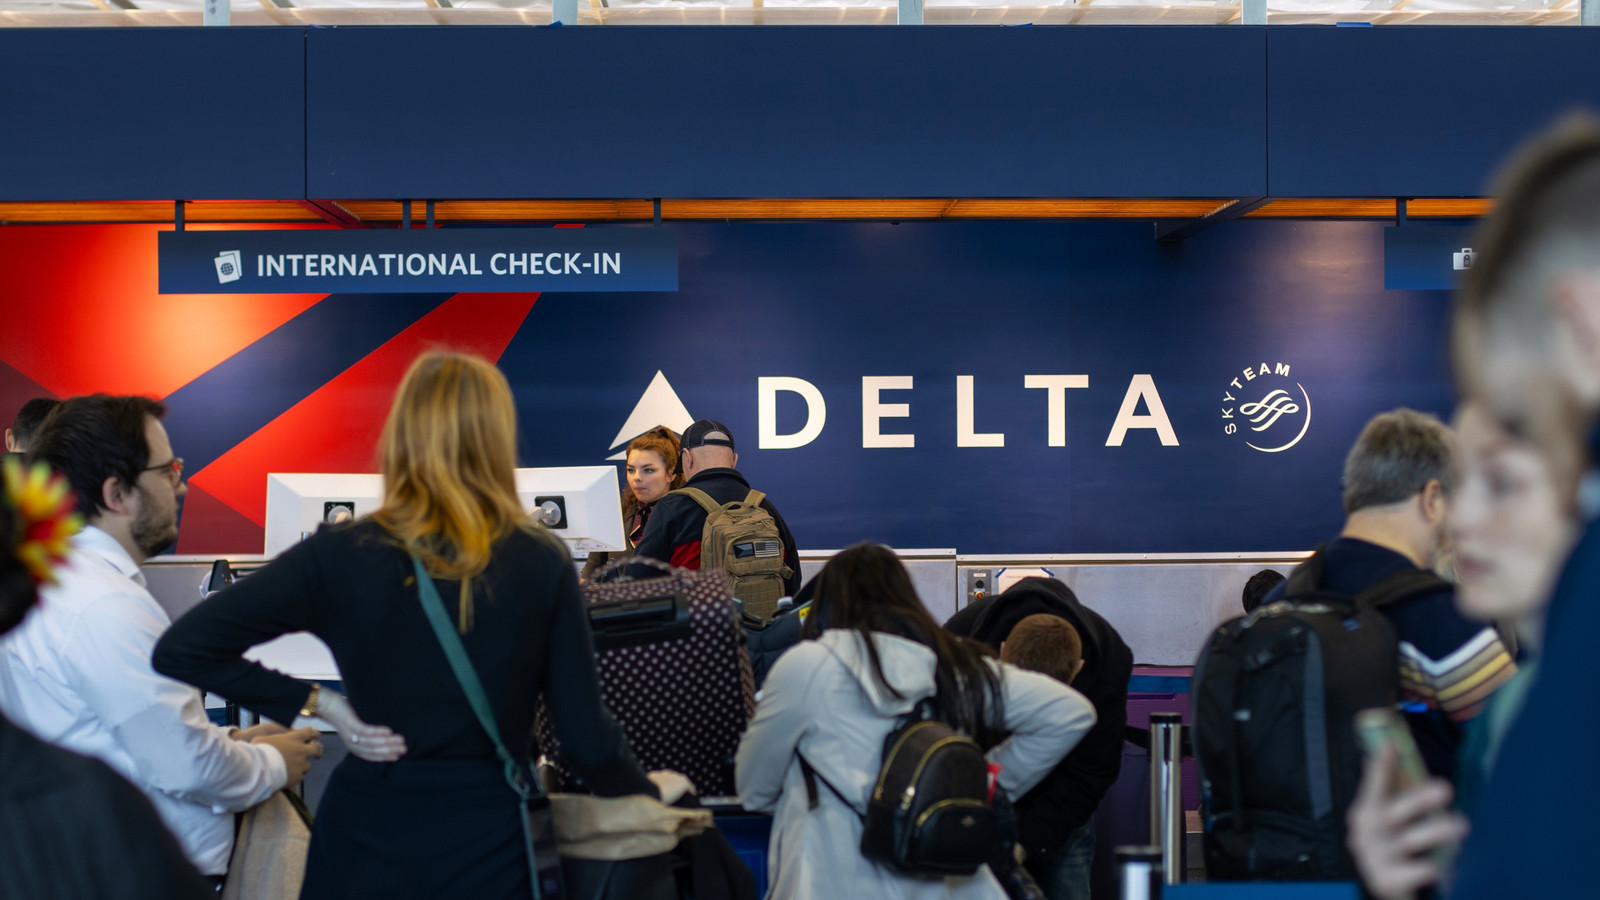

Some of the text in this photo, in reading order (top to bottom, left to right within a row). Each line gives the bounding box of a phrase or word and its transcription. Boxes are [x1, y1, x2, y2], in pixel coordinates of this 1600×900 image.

[257, 252, 621, 277] INTERNATIONAL CHECK-IN
[757, 374, 1180, 450] DELTA
[1222, 362, 1291, 435] SKYTEAM
